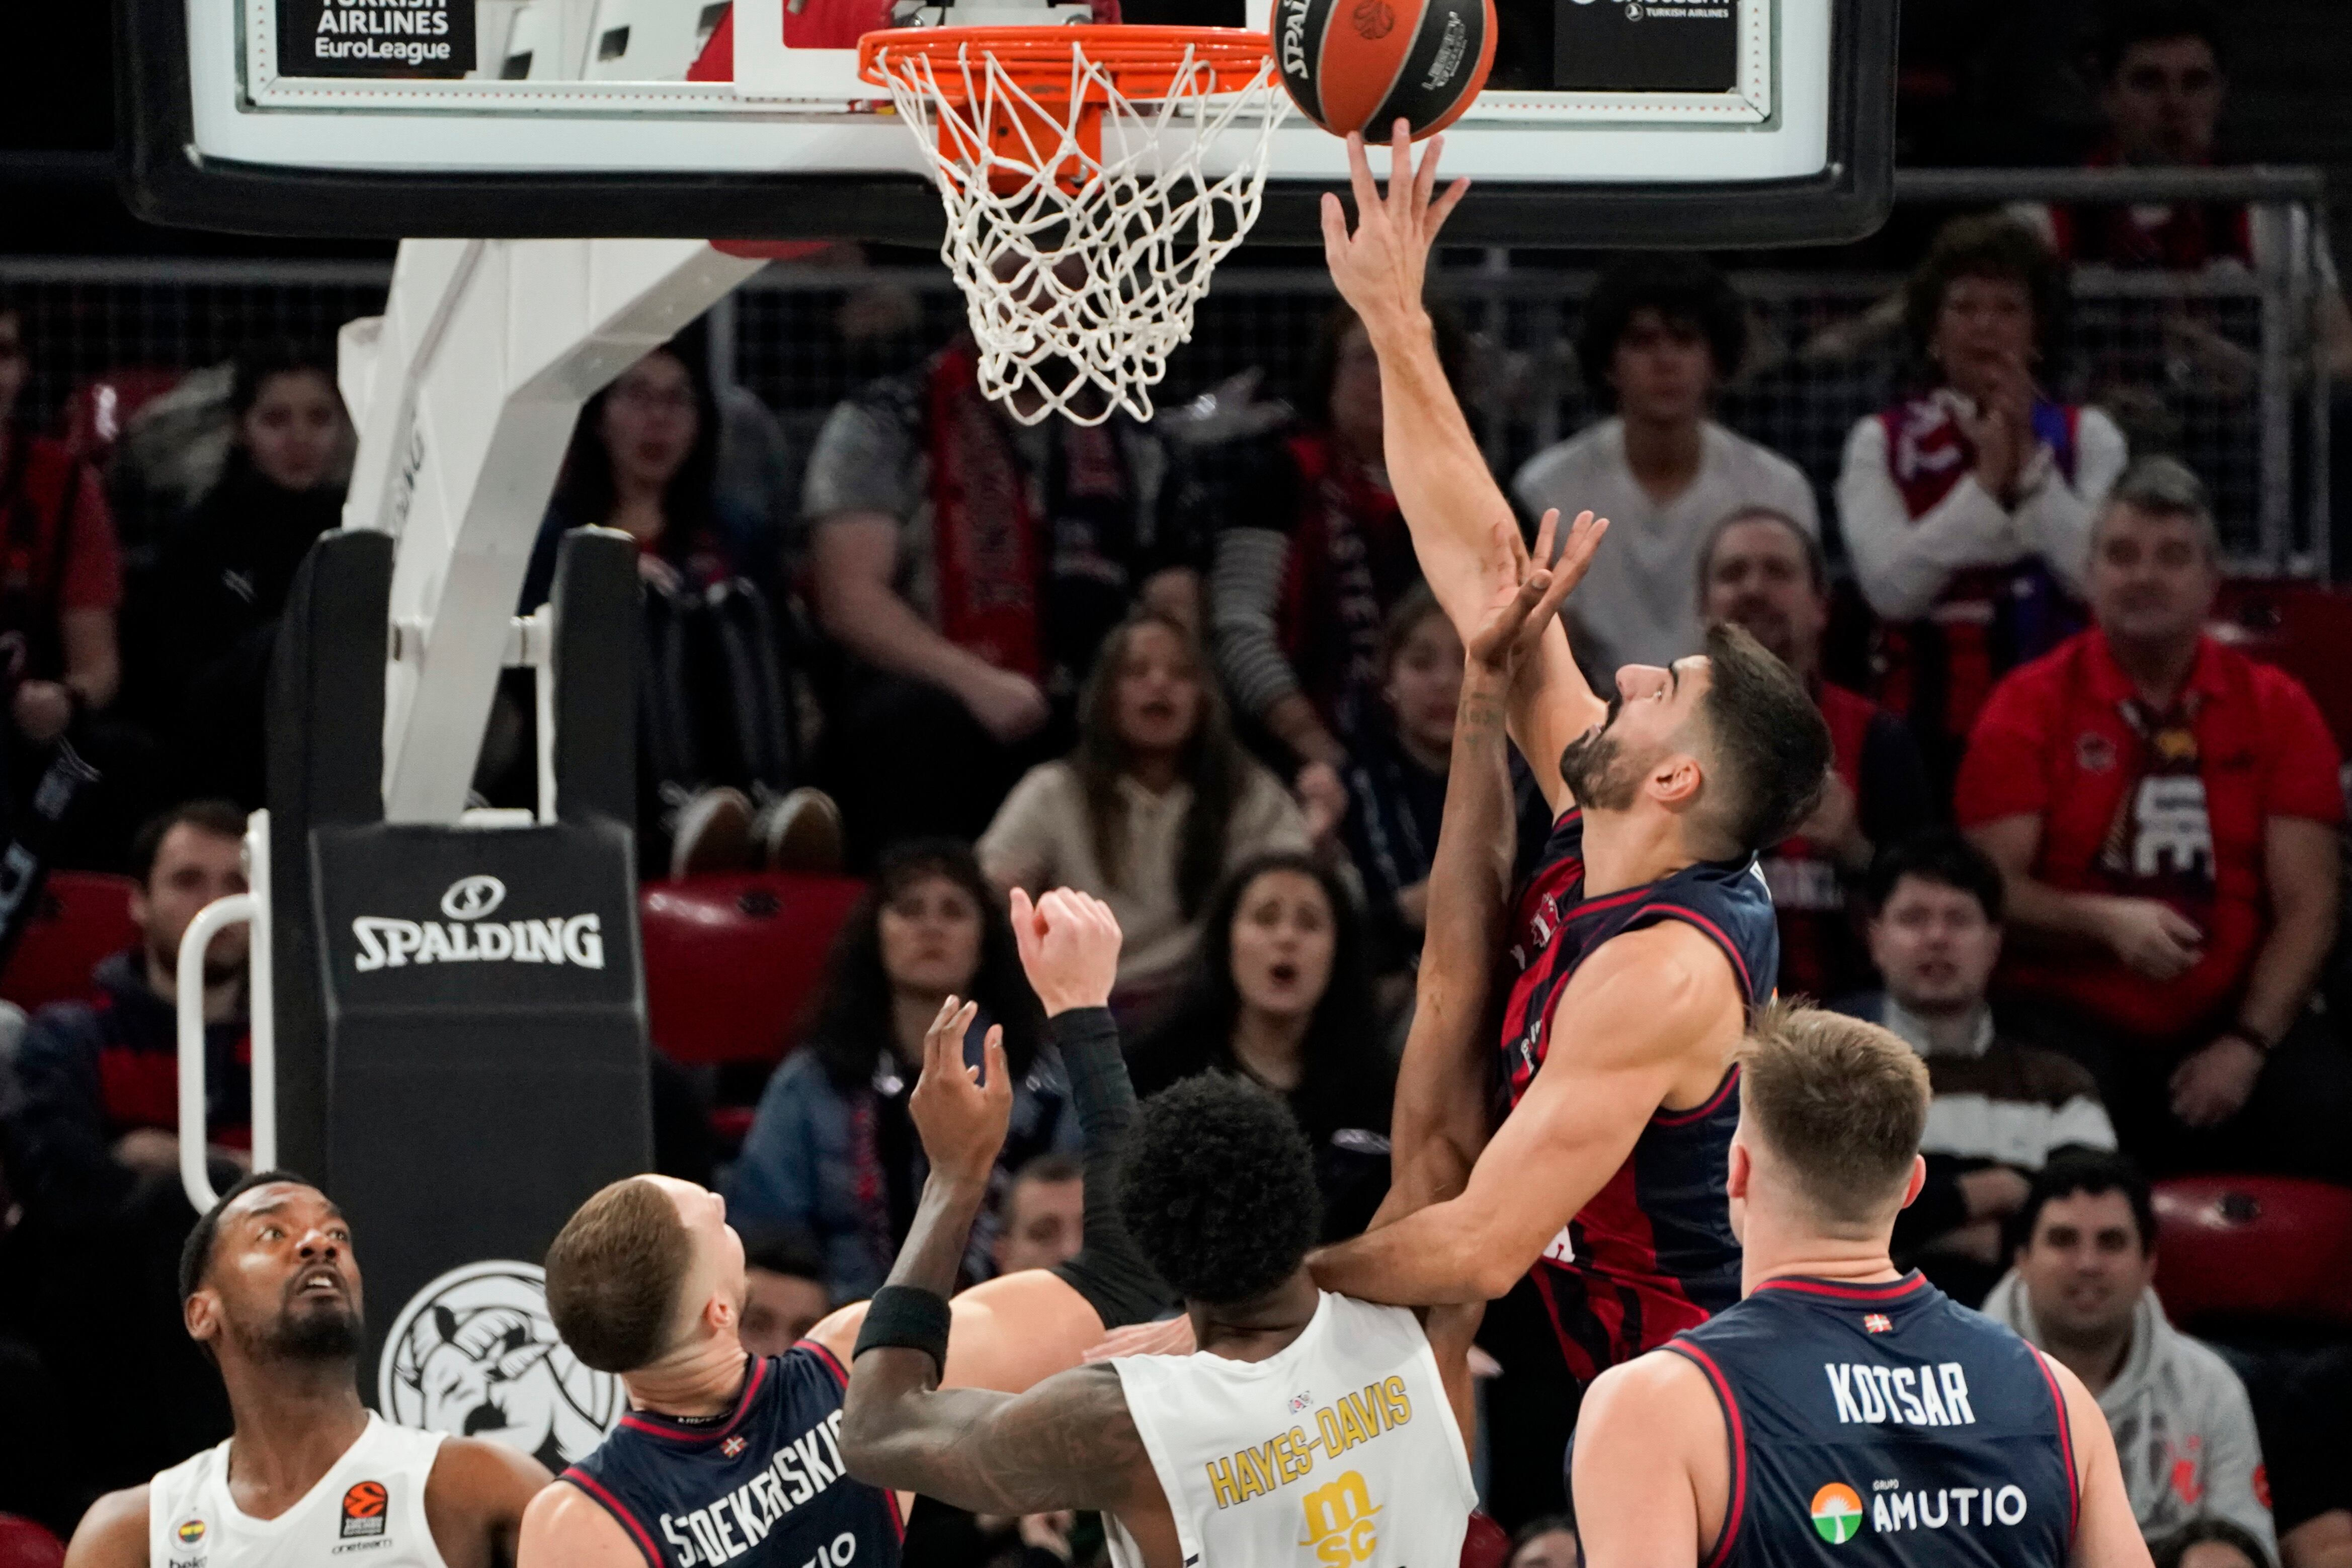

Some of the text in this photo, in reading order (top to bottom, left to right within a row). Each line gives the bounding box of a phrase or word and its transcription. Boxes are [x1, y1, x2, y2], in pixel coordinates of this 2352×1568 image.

[317, 10, 449, 35] AIRLINES
[315, 37, 451, 65] EuroLeague
[353, 913, 605, 972] SPALDING
[1825, 1362, 1976, 1426] KOTSAR
[1205, 1375, 1412, 1510] HAYES-DAVIS
[1873, 1478, 1899, 1491] GRUPO
[1873, 1484, 2027, 1533] AMUTIO
